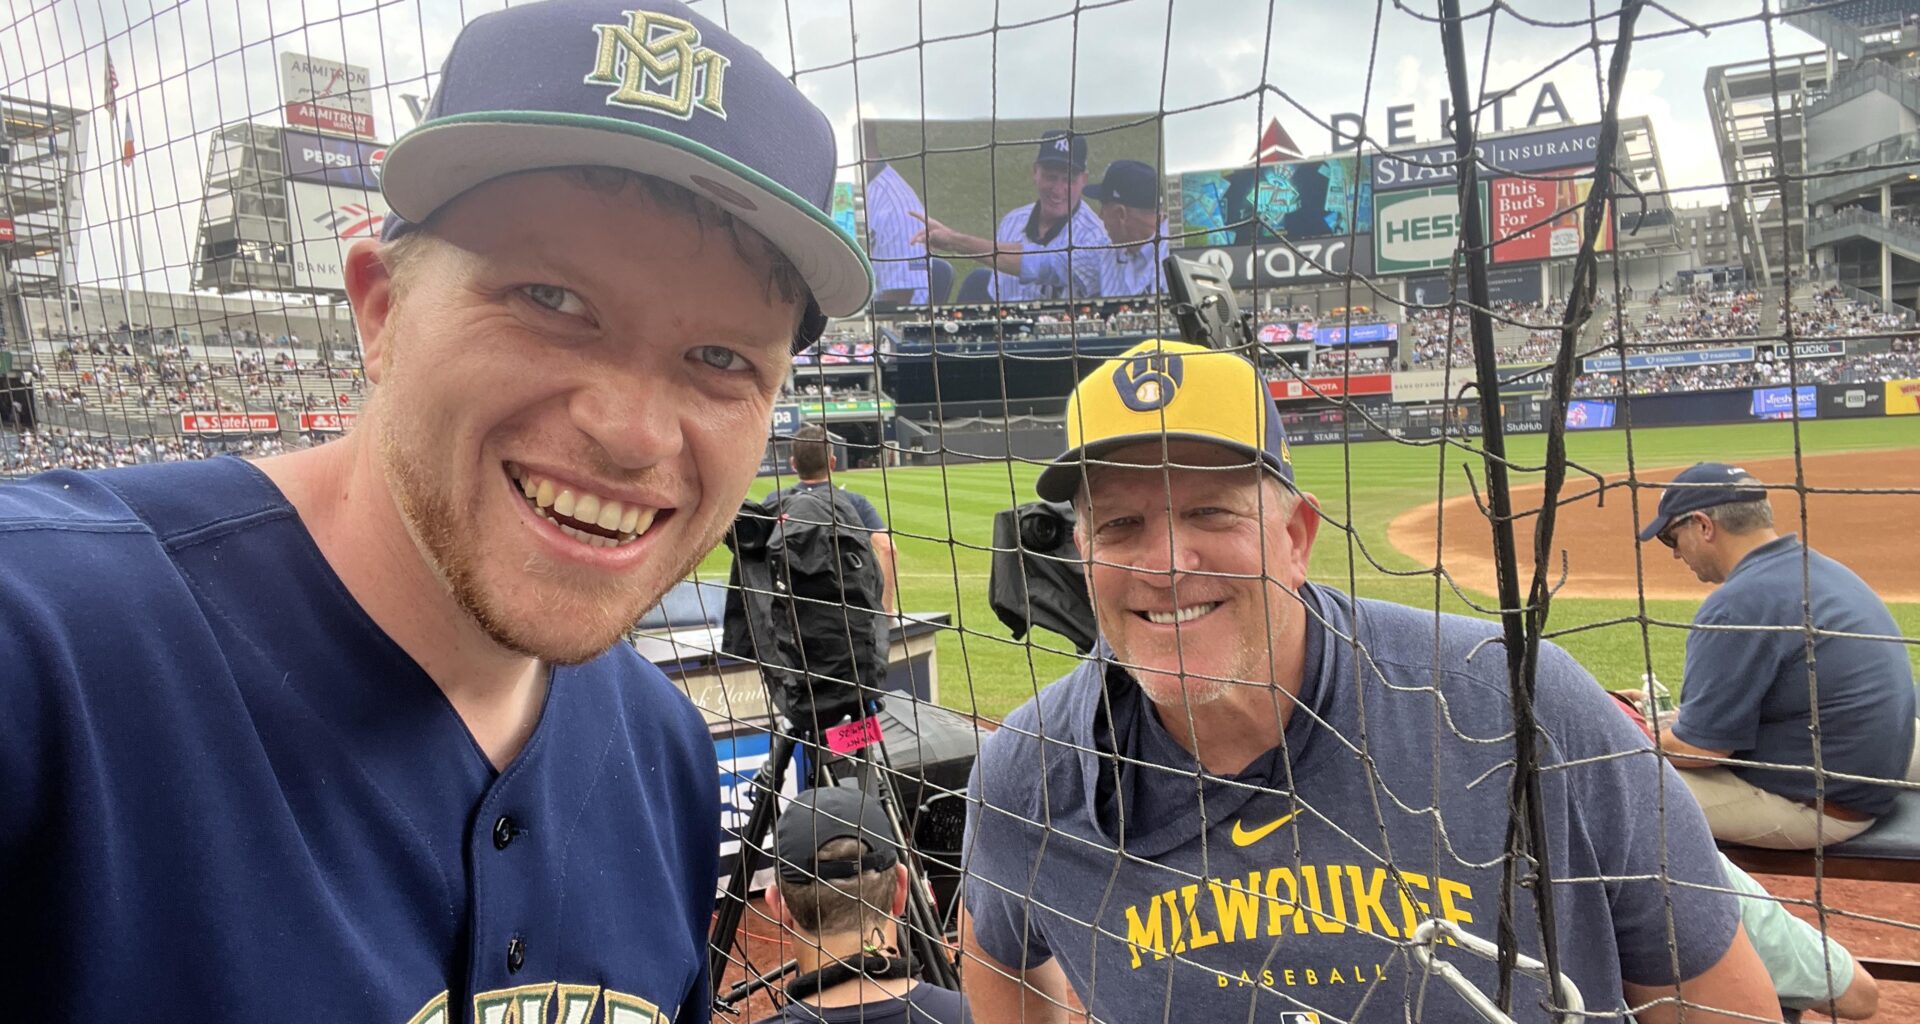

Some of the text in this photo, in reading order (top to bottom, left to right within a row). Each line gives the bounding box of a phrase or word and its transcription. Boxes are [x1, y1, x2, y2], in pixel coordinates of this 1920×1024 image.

[291, 60, 367, 84] ARMITRON
[299, 105, 367, 127] ARMITRON
[302, 148, 352, 167] PEPSI
[1499, 136, 1597, 161] INSURANC
[1498, 183, 1536, 197] This
[1499, 196, 1546, 212] Bud's
[1386, 214, 1463, 244] HES
[1499, 213, 1528, 226] For
[297, 262, 337, 274] BANK
[1246, 241, 1346, 280] razr
[1780, 344, 1829, 356] UTUCKit
[1506, 422, 1543, 432] StubHub
[1314, 433, 1340, 441] STARR
[1125, 865, 1474, 970] MILWAUKEE
[1217, 964, 1387, 988] BASEBALL
